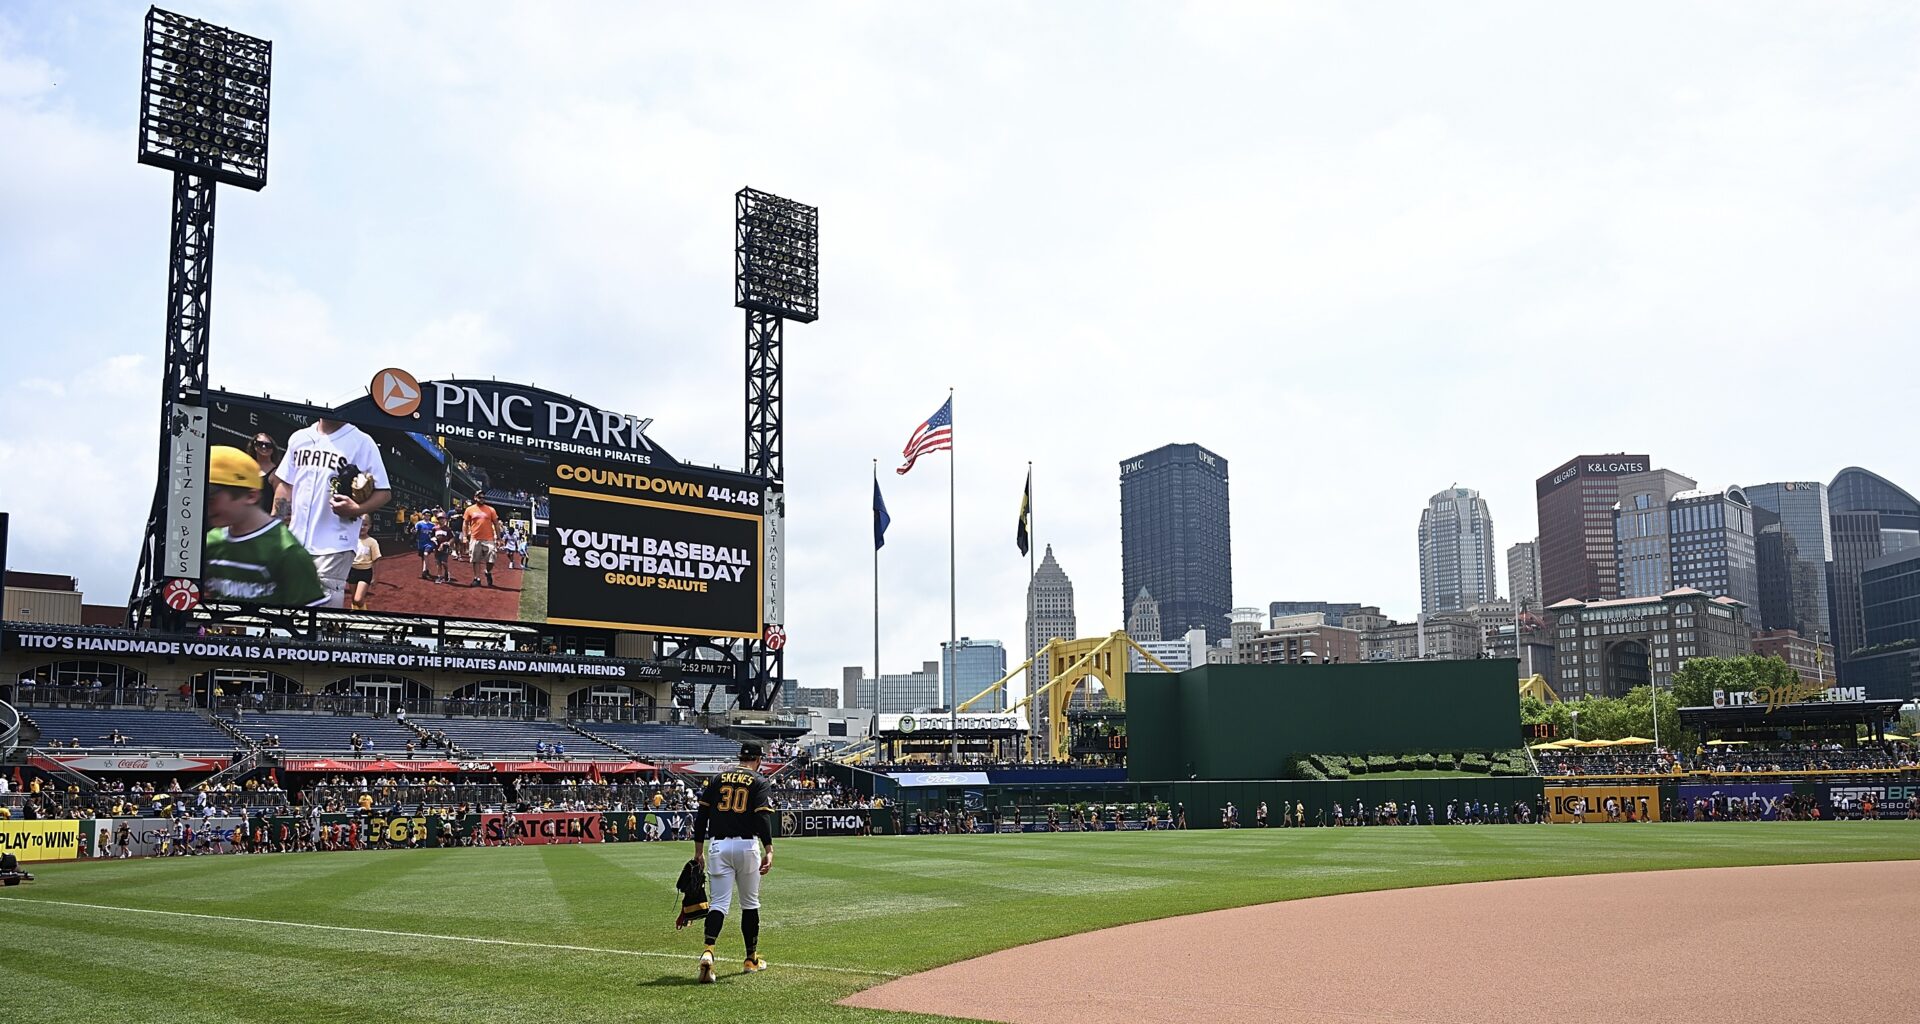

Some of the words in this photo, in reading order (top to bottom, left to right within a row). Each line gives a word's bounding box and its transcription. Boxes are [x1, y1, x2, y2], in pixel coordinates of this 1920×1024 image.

[431, 381, 532, 431] PNC
[544, 401, 654, 451] PARK
[435, 423, 474, 438] HOME
[478, 429, 495, 440] OF
[499, 433, 523, 445] THE
[527, 438, 602, 457] PITTSBURGH
[604, 450, 651, 465] PIRATES
[182, 442, 195, 489] LETZ
[1120, 460, 1144, 475] UPMC
[1199, 450, 1216, 467] UPMC
[1588, 463, 1607, 472] K&L
[1609, 463, 1643, 472] GATES
[556, 464, 704, 498] COUNTDOWN
[707, 486, 759, 506] 44:48
[181, 497, 191, 519] GO
[179, 526, 190, 573] BUCS
[556, 528, 638, 552] YOUTH
[643, 538, 751, 566] BASEBALL
[769, 546, 778, 570] MOR
[563, 548, 580, 567] &
[584, 549, 694, 578] SOFTBALL
[698, 563, 745, 583] DAY
[605, 572, 655, 588] GROUP
[658, 578, 708, 593] SALUTE
[19, 634, 74, 649] TITO'S
[77, 637, 180, 654] HANDMADE
[183, 642, 243, 657] VODKA
[246, 646, 260, 658] IS
[264, 648, 278, 659] A
[278, 648, 329, 662] PROUD
[332, 651, 395, 665] PARTNER
[398, 654, 415, 666] OF
[417, 655, 442, 667] THE
[444, 657, 496, 670] PIRATES
[498, 659, 526, 671] AND
[528, 661, 576, 674] ANIMAL
[578, 664, 626, 676] FRIENDS
[640, 666, 661, 675] Tito's
[681, 663, 699, 672] 2:52
[701, 665, 714, 673] PM
[1729, 691, 1757, 705] IT'S
[919, 718, 949, 730] FAT
[955, 717, 1018, 730] HEAD'S
[721, 773, 754, 786] SKENES
[717, 785, 750, 814] 30
[32, 835, 43, 847] TO
[45, 831, 75, 848] WIN!
